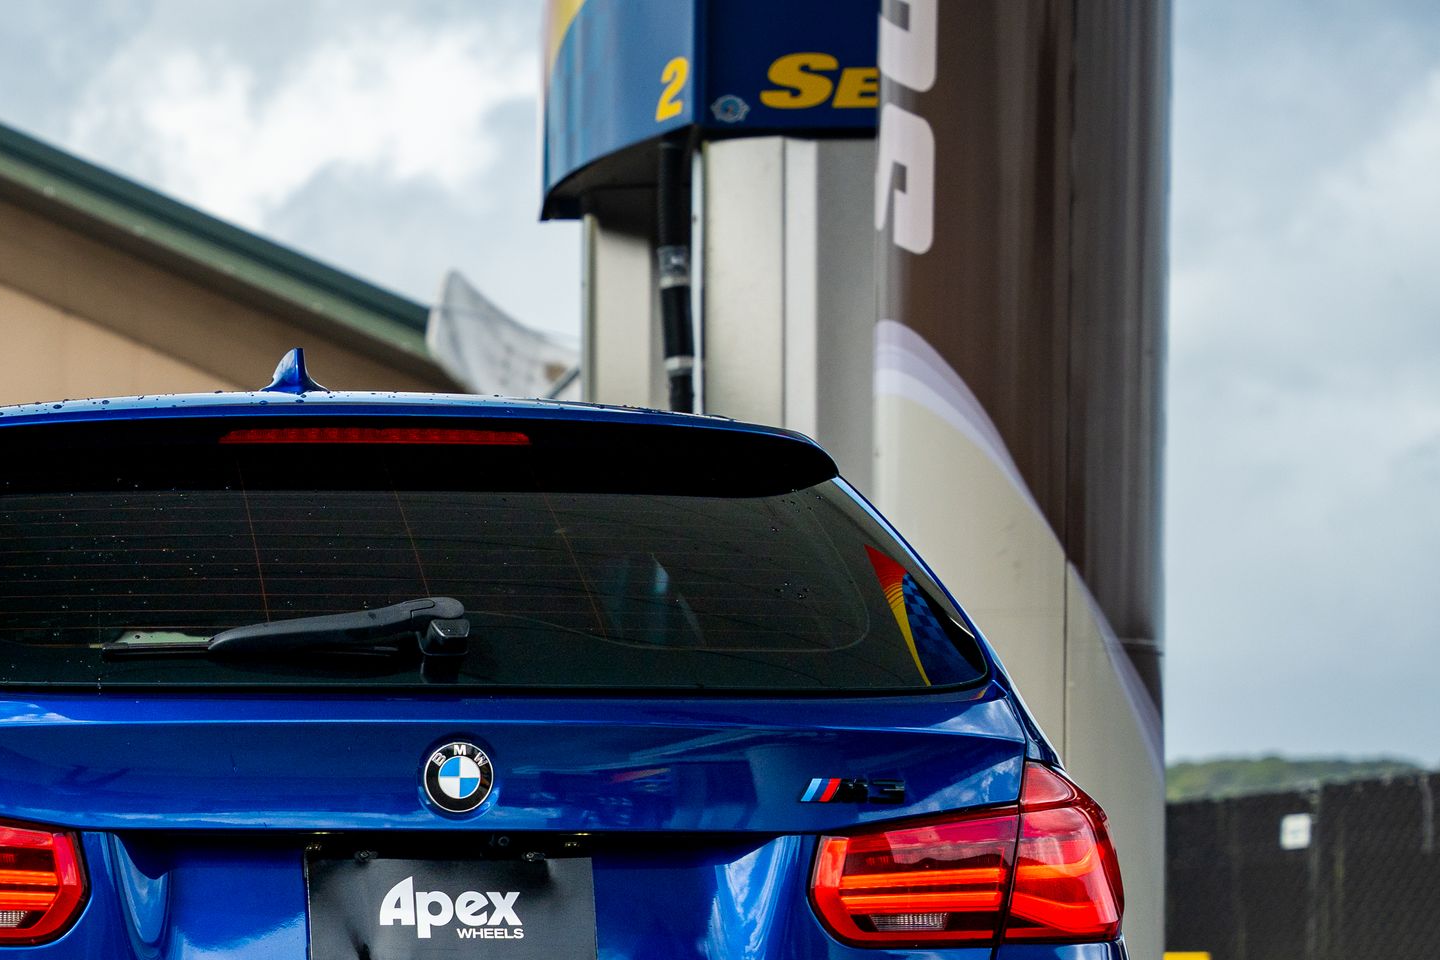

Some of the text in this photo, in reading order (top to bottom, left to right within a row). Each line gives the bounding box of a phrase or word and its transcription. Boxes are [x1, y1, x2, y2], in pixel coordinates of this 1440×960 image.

[655, 57, 689, 122] 2
[431, 744, 490, 767] BMW
[822, 778, 905, 804] M3
[379, 876, 523, 939] Apex
[456, 928, 525, 939] WHEELS
